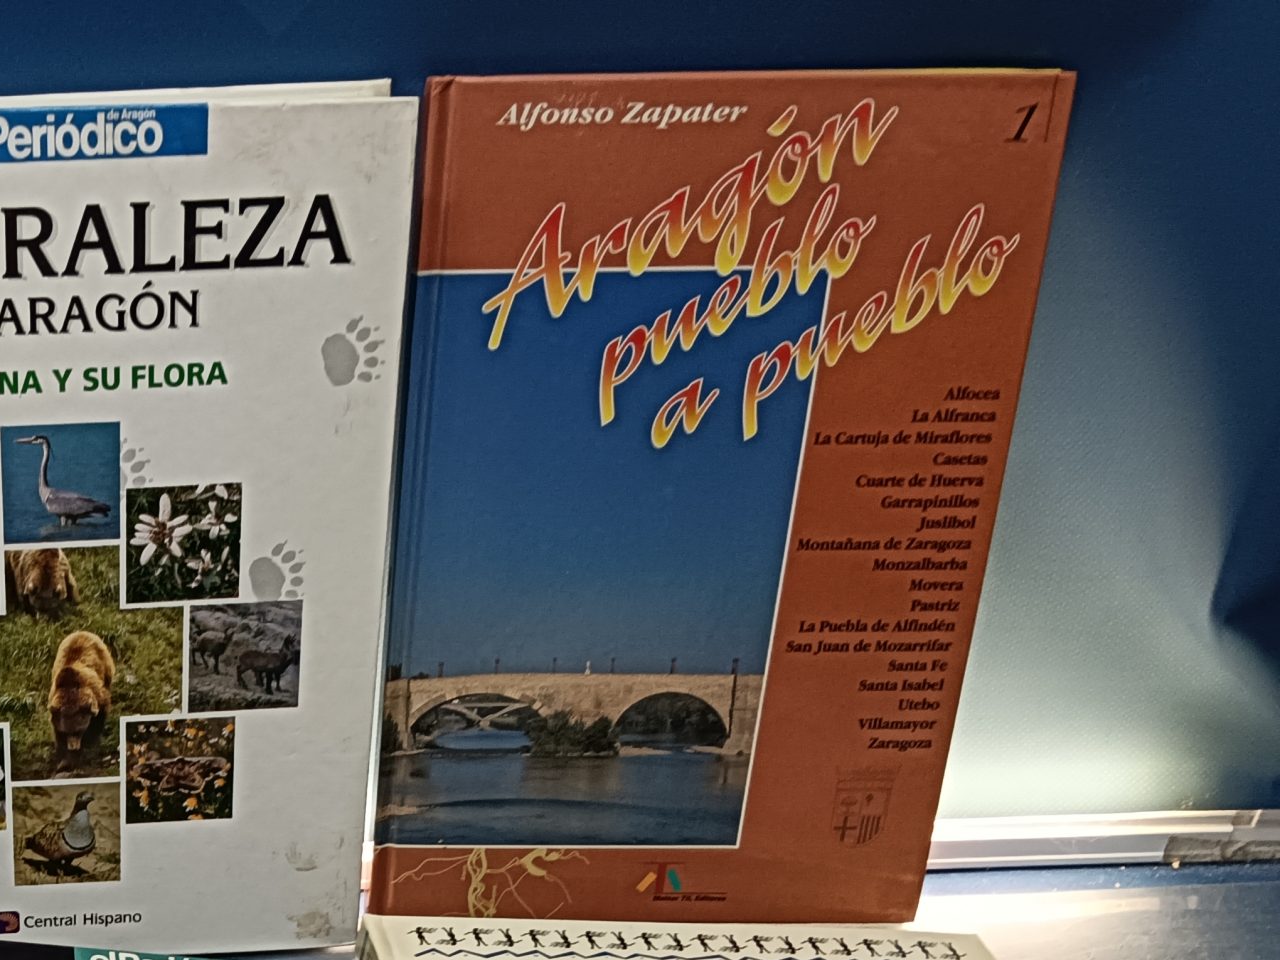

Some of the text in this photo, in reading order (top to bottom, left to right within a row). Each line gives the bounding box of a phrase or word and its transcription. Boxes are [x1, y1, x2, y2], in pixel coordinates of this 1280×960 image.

[496, 101, 748, 131] Alfonso Zapater
[1003, 101, 1039, 143] 1
[482, 98, 899, 351] Aragón
[600, 184, 877, 427] pueblo
[650, 203, 1020, 448] a pueblo
[52, 368, 73, 394] Y
[82, 365, 121, 391] SU
[130, 361, 228, 390] FLORA
[944, 386, 1001, 401] Alfocea
[911, 408, 997, 423] La Alfranca
[813, 430, 993, 449] La Cartuja de Miraflores
[932, 452, 988, 466] Casetas
[855, 473, 984, 488] Cuarte de Huerva
[880, 494, 980, 513] Garrapinillos
[915, 515, 977, 533] Juslibol
[796, 537, 972, 553] Montañana de Zaragoza
[872, 557, 968, 572] Monzalbarba
[908, 579, 964, 592] Movera
[910, 599, 960, 612] Pastriz
[798, 618, 956, 633] La Puebla de Alfindén
[785, 638, 952, 655] San Juan de Mozarrifar
[887, 659, 948, 672] Santa Fe
[857, 678, 945, 692] Santa Isabel
[898, 698, 940, 711] Utebo
[858, 718, 937, 733] Villamayor
[868, 737, 932, 752] Zaragoza
[23, 911, 142, 929] Central Hispano
